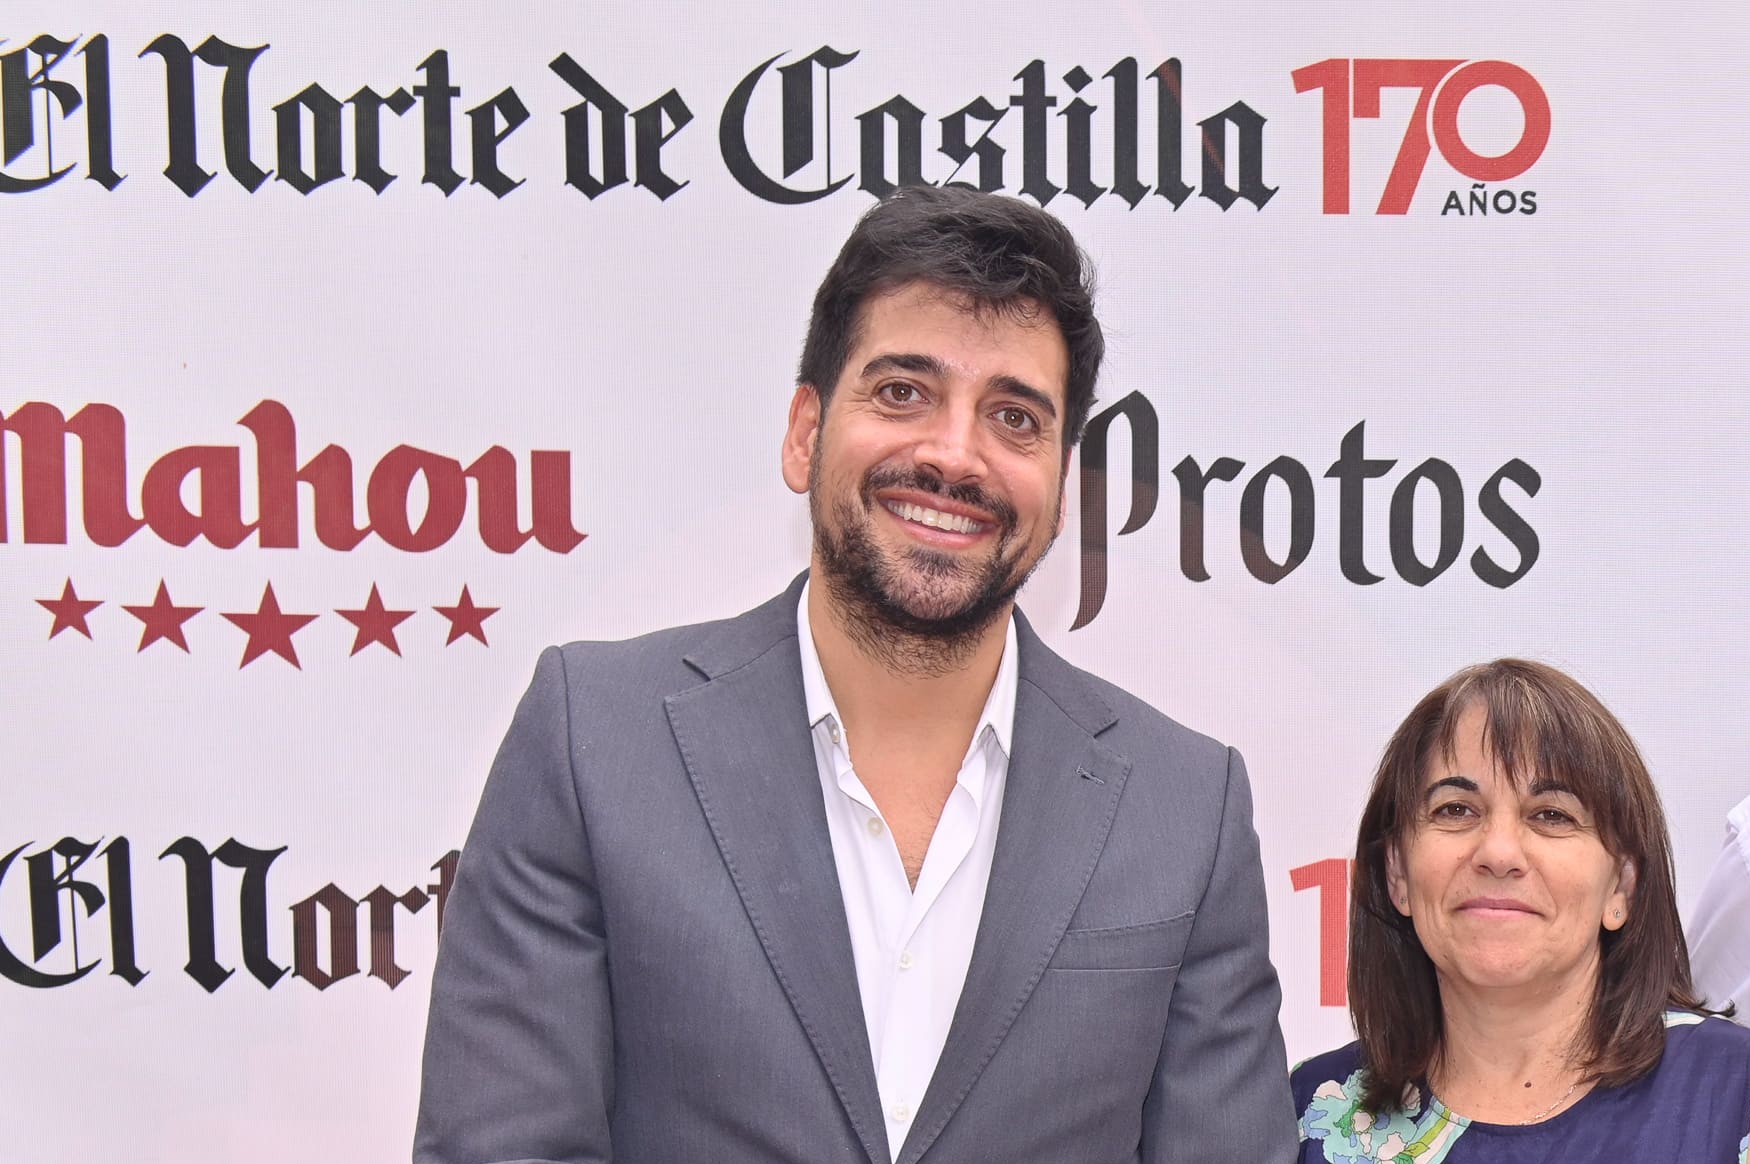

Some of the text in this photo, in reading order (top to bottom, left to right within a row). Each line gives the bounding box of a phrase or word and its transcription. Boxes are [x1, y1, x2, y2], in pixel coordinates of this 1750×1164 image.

[0, 33, 1552, 216] El Norte de Castilla 170
[1441, 184, 1538, 217] AÑOS
[0, 399, 589, 555] Mahou
[1069, 389, 1542, 633] Protos
[0, 835, 151, 989] El
